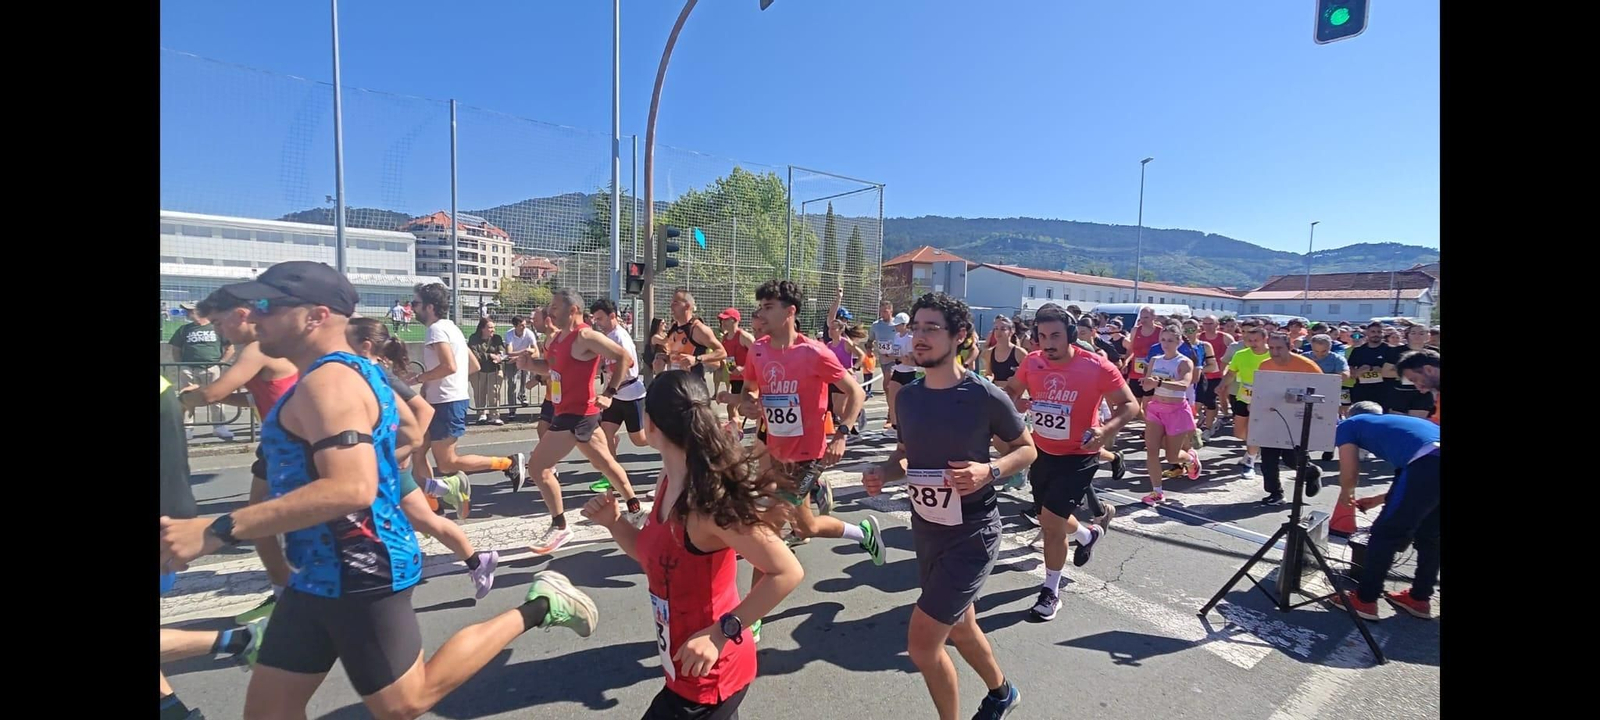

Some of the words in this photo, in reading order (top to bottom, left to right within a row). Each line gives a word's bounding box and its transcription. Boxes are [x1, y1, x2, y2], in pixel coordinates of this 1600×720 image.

[770, 380, 798, 394] CABO
[1047, 389, 1078, 402] CABO
[766, 407, 798, 424] 286
[1035, 412, 1066, 430] 282
[908, 485, 952, 509] 287
